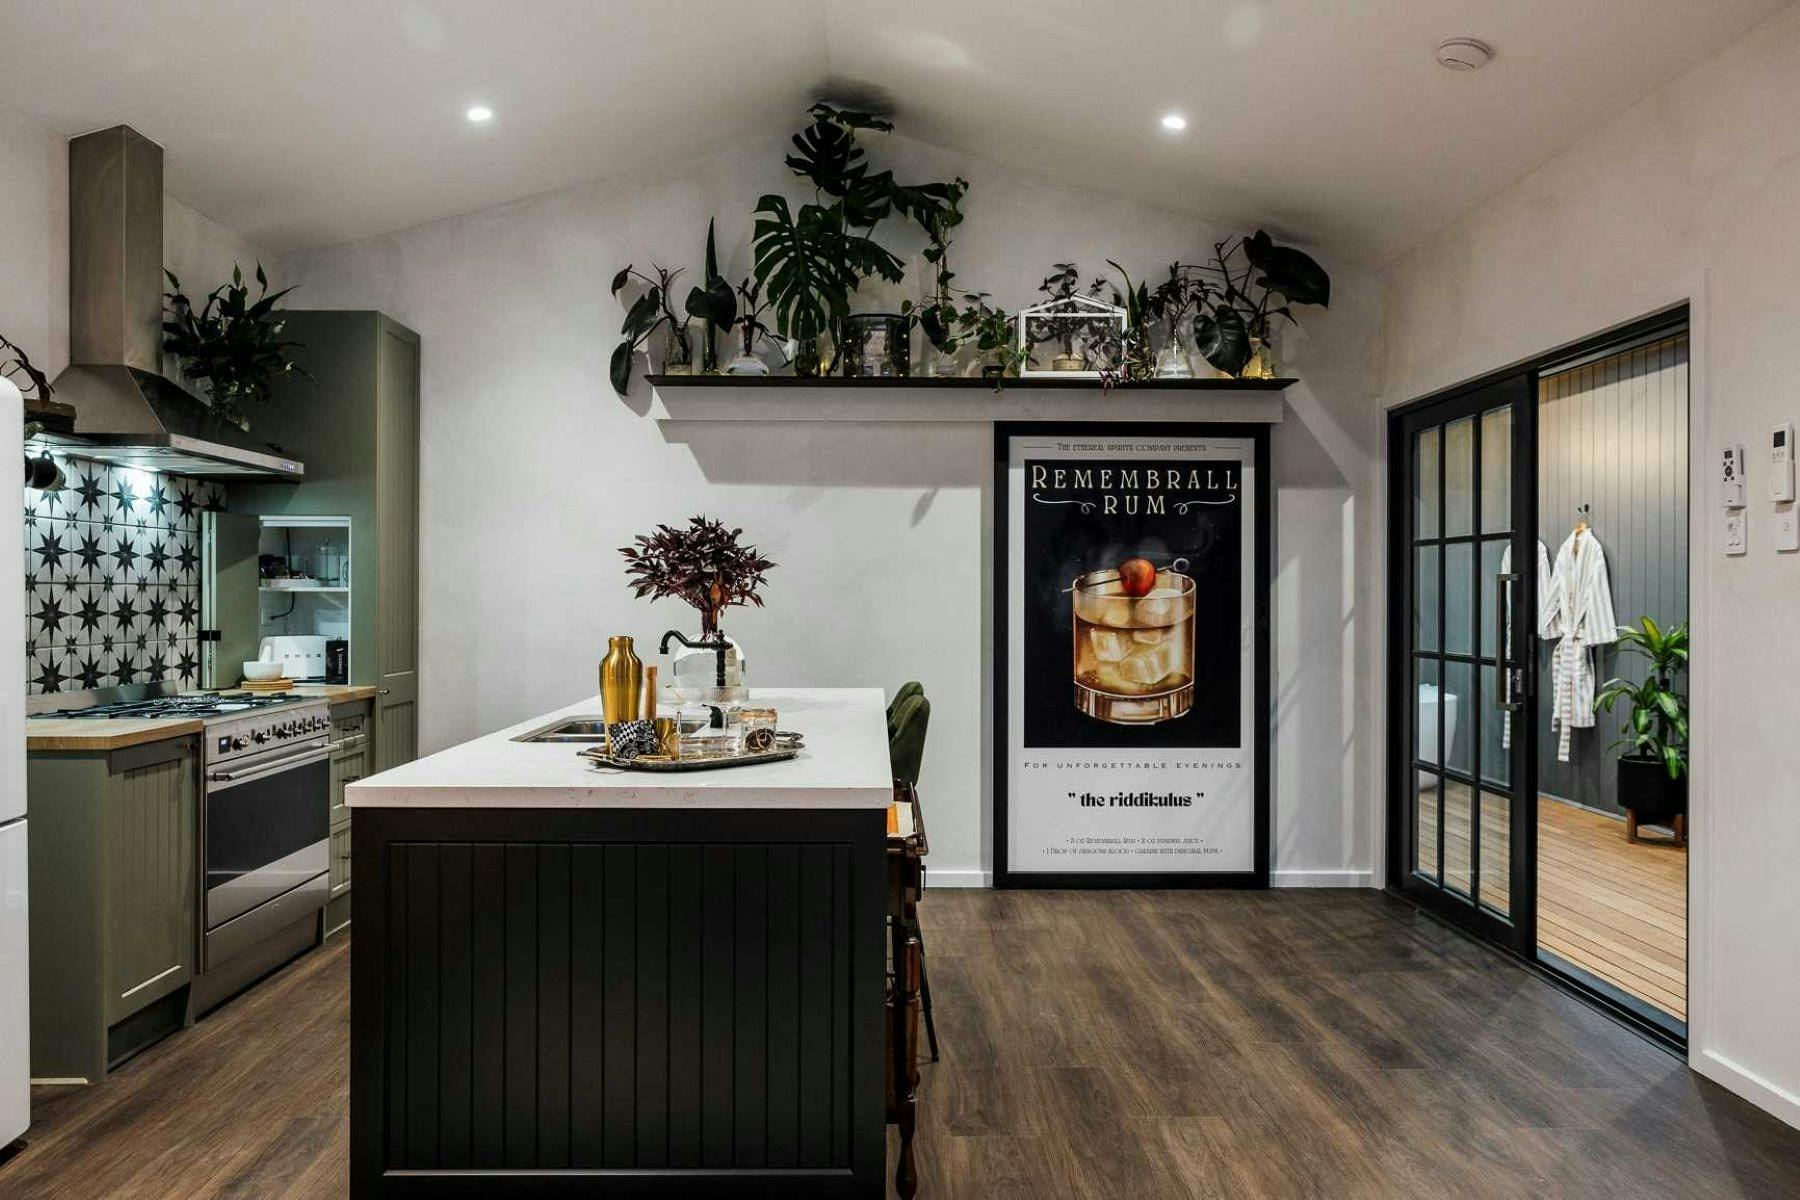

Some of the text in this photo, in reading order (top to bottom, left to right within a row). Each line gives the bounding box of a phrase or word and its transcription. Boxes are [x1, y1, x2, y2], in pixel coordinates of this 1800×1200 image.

[1031, 465, 1238, 489] REMEMBRALL
[1104, 495, 1166, 515] RUM
[1109, 792, 1192, 807] riddikulus
